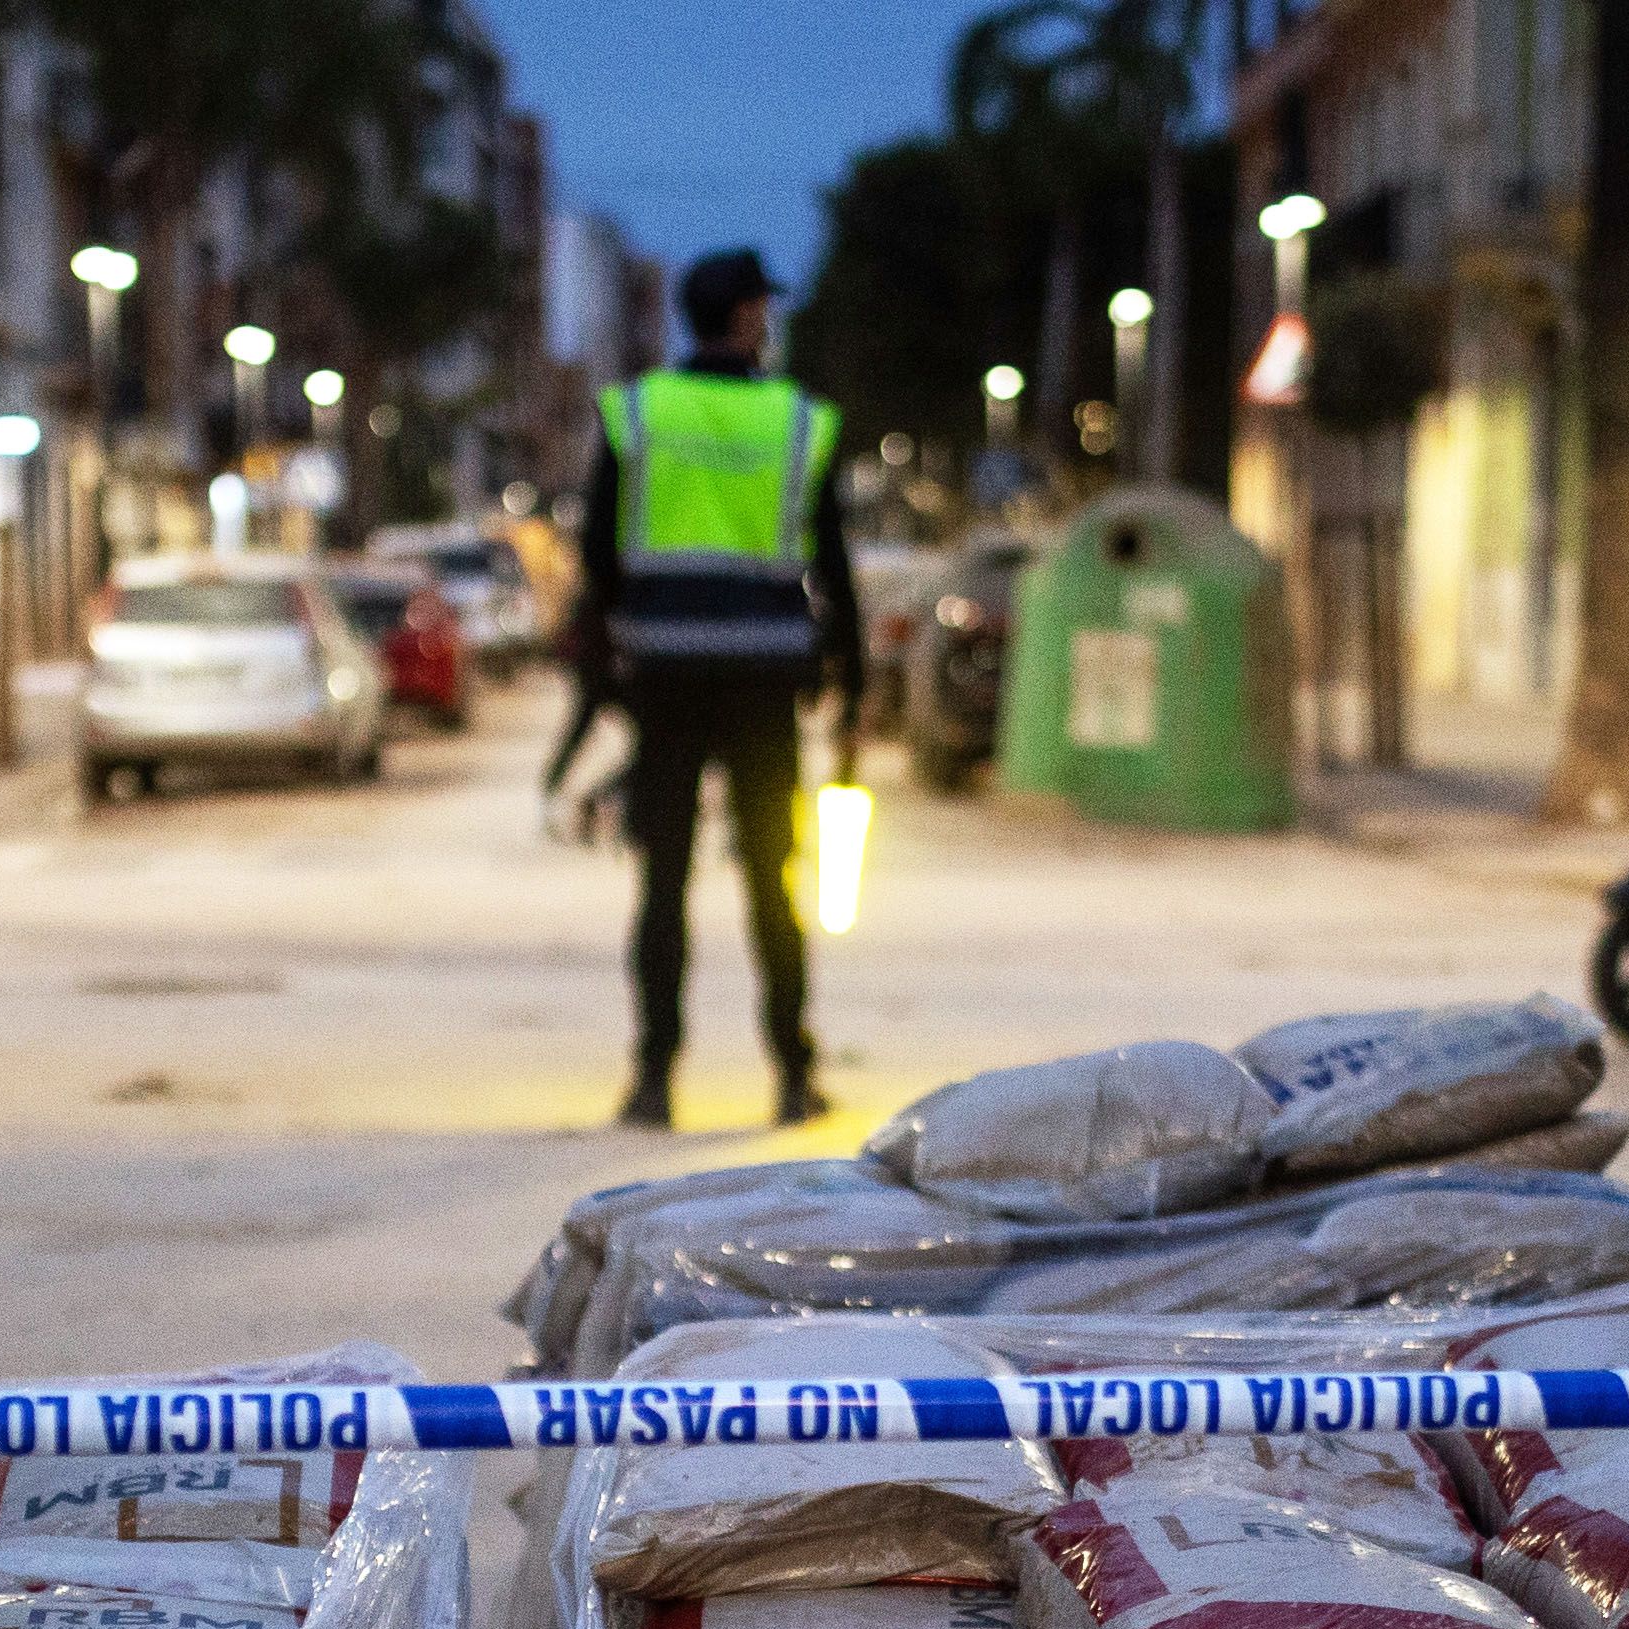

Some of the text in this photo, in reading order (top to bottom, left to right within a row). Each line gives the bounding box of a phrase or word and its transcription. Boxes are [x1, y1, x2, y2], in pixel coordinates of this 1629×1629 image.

[99, 1393, 368, 1456] POLICIA
[537, 1388, 757, 1446] PASAR
[789, 1382, 879, 1442] NO
[1021, 1377, 1220, 1435] LOCAL
[1248, 1375, 1500, 1433] POLICIA
[23, 1469, 231, 1522] RBM
[950, 1586, 1016, 1629] BM
